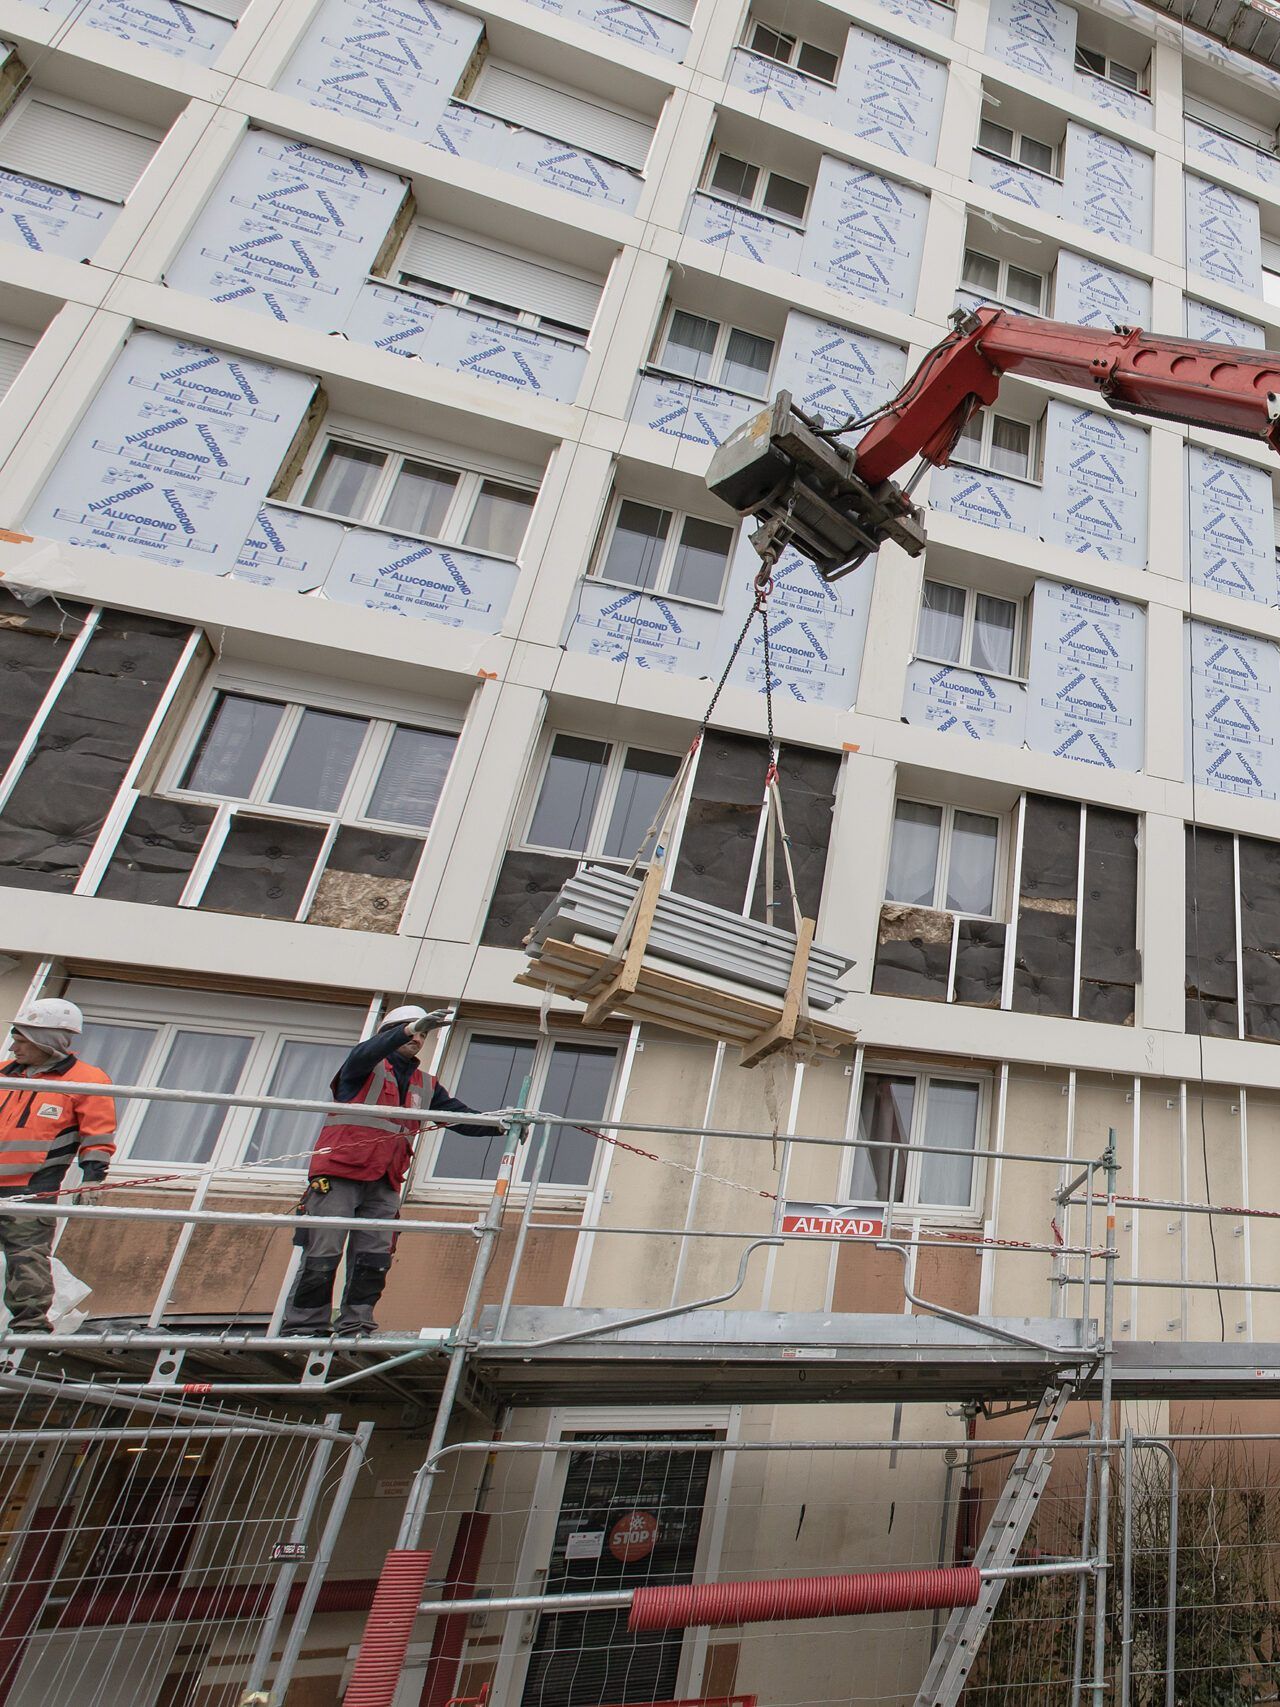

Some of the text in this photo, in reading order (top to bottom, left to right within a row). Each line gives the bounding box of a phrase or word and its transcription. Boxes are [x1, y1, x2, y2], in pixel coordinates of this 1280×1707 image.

[117, 2, 180, 28] ALUCOBOND
[377, 4, 429, 26] ALUCOBOND
[109, 15, 128, 25] MADE
[138, 24, 173, 40] GERMANY
[345, 30, 390, 44] ALUCOBOND
[355, 42, 409, 65] ALUCOBOND
[396, 37, 422, 70] ALUCOBOND
[322, 70, 368, 86] ALUCOBOND
[332, 85, 388, 108] ALUCOBOND
[375, 77, 401, 112] ALUCOBOND
[295, 152, 353, 175] ALUCOBOND
[538, 152, 577, 167] ALUCOBOND
[548, 166, 597, 187] ALUCOBOND
[583, 158, 608, 191] ALUCOBOND
[257, 183, 309, 202] ALUCOBOND
[853, 184, 892, 202] ALUCOBOND
[269, 200, 330, 223] ALUCOBOND
[315, 189, 345, 228] ALUCOBOND
[838, 210, 868, 226] ALUCOBOND
[262, 215, 282, 224] MADE
[290, 222, 322, 236] GERMANY
[846, 223, 886, 241] ALUCOBOND
[873, 215, 896, 245] ALUCOBOND
[229, 233, 283, 253] ALUCOBOND
[241, 251, 304, 275] ALUCOBOND
[290, 239, 319, 279] ALUCOBOND
[830, 250, 861, 266] ALUCOBOND
[234, 267, 254, 277] MADE
[263, 275, 297, 288] GERMANY
[839, 264, 879, 282] ALUCOBOND
[866, 255, 889, 285] ALUCOBOND
[374, 325, 424, 348] ALUCOBOND
[485, 327, 503, 337] MADE
[512, 334, 540, 348] GERMANY
[812, 338, 844, 356] ALUCOBOND
[459, 345, 505, 367] ALUCOBOND
[821, 354, 864, 373] ALUCOBOND
[850, 343, 874, 376] ALUCOBOND
[160, 356, 220, 381] ALUCOBOND
[470, 365, 527, 386] ALUCOBOND
[512, 351, 540, 390] ALUCOBOND
[172, 378, 241, 401] ALUCOBOND
[227, 362, 259, 406] ALUCOBOND
[803, 384, 836, 403] ALUCOBOND
[164, 395, 185, 407] MADE
[194, 403, 234, 418] GERMANY
[649, 406, 688, 430] ALUCOBOND
[125, 417, 188, 444] ALUCOBOND
[659, 427, 709, 445] ALUCOBOND
[1080, 423, 1116, 438] ALUCOBOND
[139, 440, 210, 464] ALUCOBOND
[195, 422, 228, 469] ALUCOBOND
[129, 460, 151, 470] MADE
[162, 468, 202, 481] GERMANY
[1070, 450, 1096, 469] ALUCOBOND
[1100, 454, 1123, 485] ALUCOBOND
[1077, 467, 1114, 483] ALUCOBOND
[1204, 470, 1224, 488] ALUCOBOND
[87, 482, 154, 512] ALUCOBOND
[950, 482, 982, 504] ALUCOBOND
[1210, 486, 1243, 500] ALUCOBOND
[1229, 474, 1251, 502] ALUCOBOND
[162, 487, 196, 536] ALUCOBOND
[960, 501, 1001, 517] ALUCOBOND
[986, 487, 1012, 520] ALUCOBOND
[1067, 495, 1093, 516] ALUCOBOND
[101, 507, 177, 531] ALUCOBOND
[1075, 513, 1113, 529] ALUCOBOND
[1099, 500, 1123, 531] ALUCOBOND
[92, 529, 115, 539] MADE
[126, 536, 168, 550] GERMANY
[1210, 530, 1244, 544] ALUCOBOND
[379, 547, 432, 577] ALUCOBOND
[390, 572, 455, 593] ALUCOBOND
[440, 553, 471, 596] ALUCOBOND
[1211, 577, 1246, 590] ALUCOBOND
[1231, 561, 1255, 592] ALUCOBOND
[776, 581, 826, 599] ALUCOBOND
[1071, 589, 1110, 604] ALUCOBOND
[384, 592, 404, 602] MADE
[414, 598, 449, 611] GERMANY
[773, 599, 788, 607] MADE
[797, 604, 823, 615] GERMANY
[611, 612, 668, 631] ALUCOBOND
[1059, 620, 1087, 644] ALUCOBOND
[607, 632, 623, 641] MADE
[632, 637, 664, 648] GERMANY
[799, 621, 828, 661] ALUCOBOND
[1068, 641, 1108, 656] ALUCOBOND
[1092, 624, 1119, 658] ALUCOBOND
[1205, 644, 1228, 667] ALUCOBOND
[1233, 648, 1258, 680] ALUCOBOND
[1213, 664, 1248, 679] ALUCOBOND
[939, 681, 985, 696] ALUCOBOND
[1056, 673, 1085, 699] ALUCOBOND
[1091, 677, 1117, 713] ALUCOBOND
[1065, 696, 1107, 711] ALUCOBOND
[1206, 695, 1230, 720] ALUCOBOND
[1213, 717, 1250, 731] ALUCOBOND
[1234, 699, 1260, 732] ALUCOBOND
[1053, 730, 1083, 756] ALUCOBOND
[1206, 749, 1232, 775] ALUCOBOND
[1236, 752, 1262, 787] ALUCOBOND
[1214, 772, 1252, 786] ALUCOBOND
[793, 1217, 874, 1235] ALTRAD
[613, 1531, 650, 1545] STOP
